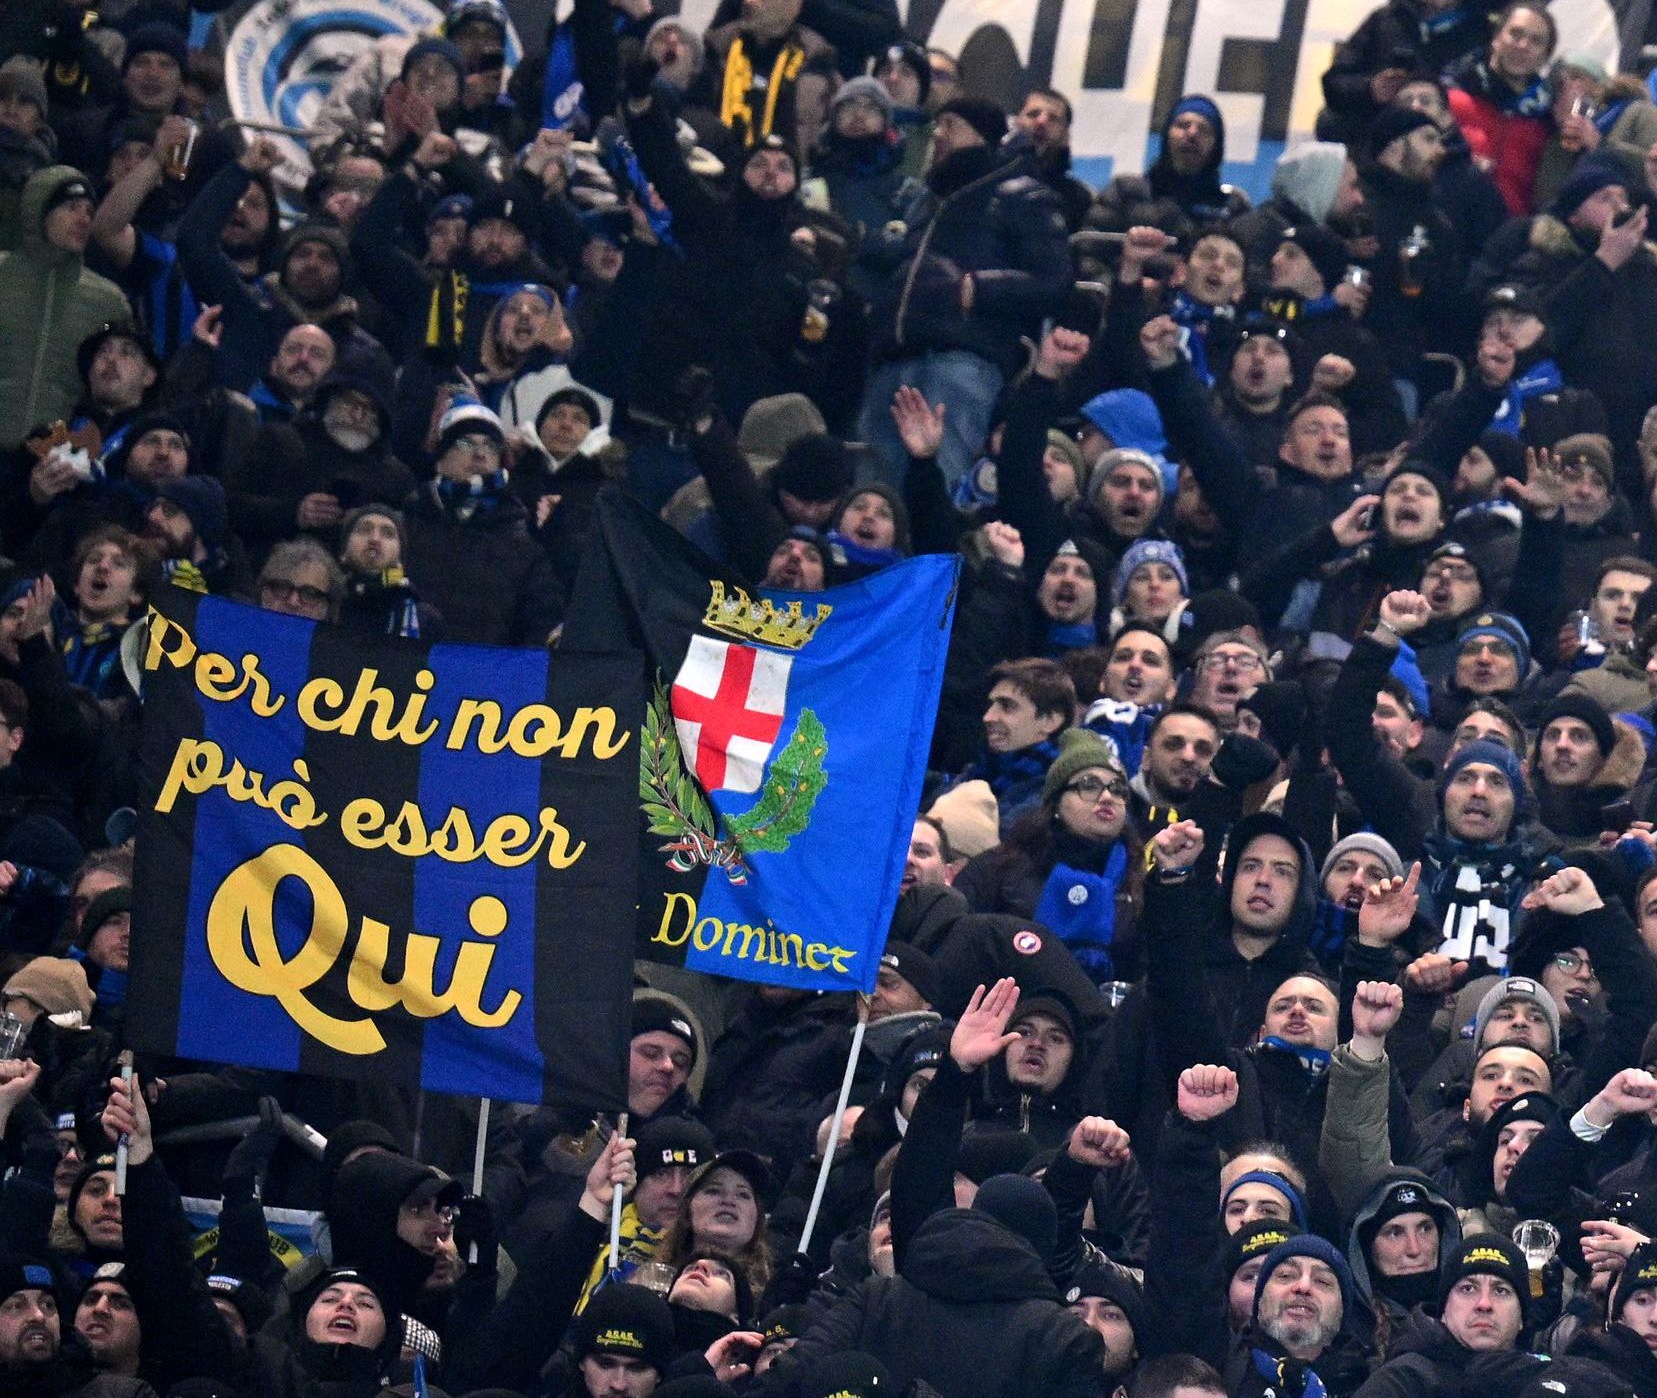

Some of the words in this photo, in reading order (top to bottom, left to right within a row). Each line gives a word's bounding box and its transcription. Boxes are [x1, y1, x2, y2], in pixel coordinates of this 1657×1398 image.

[297, 667, 437, 746] chi
[448, 698, 631, 760] non
[154, 737, 328, 830] può
[341, 798, 585, 870] esser
[206, 842, 524, 1057] Qui
